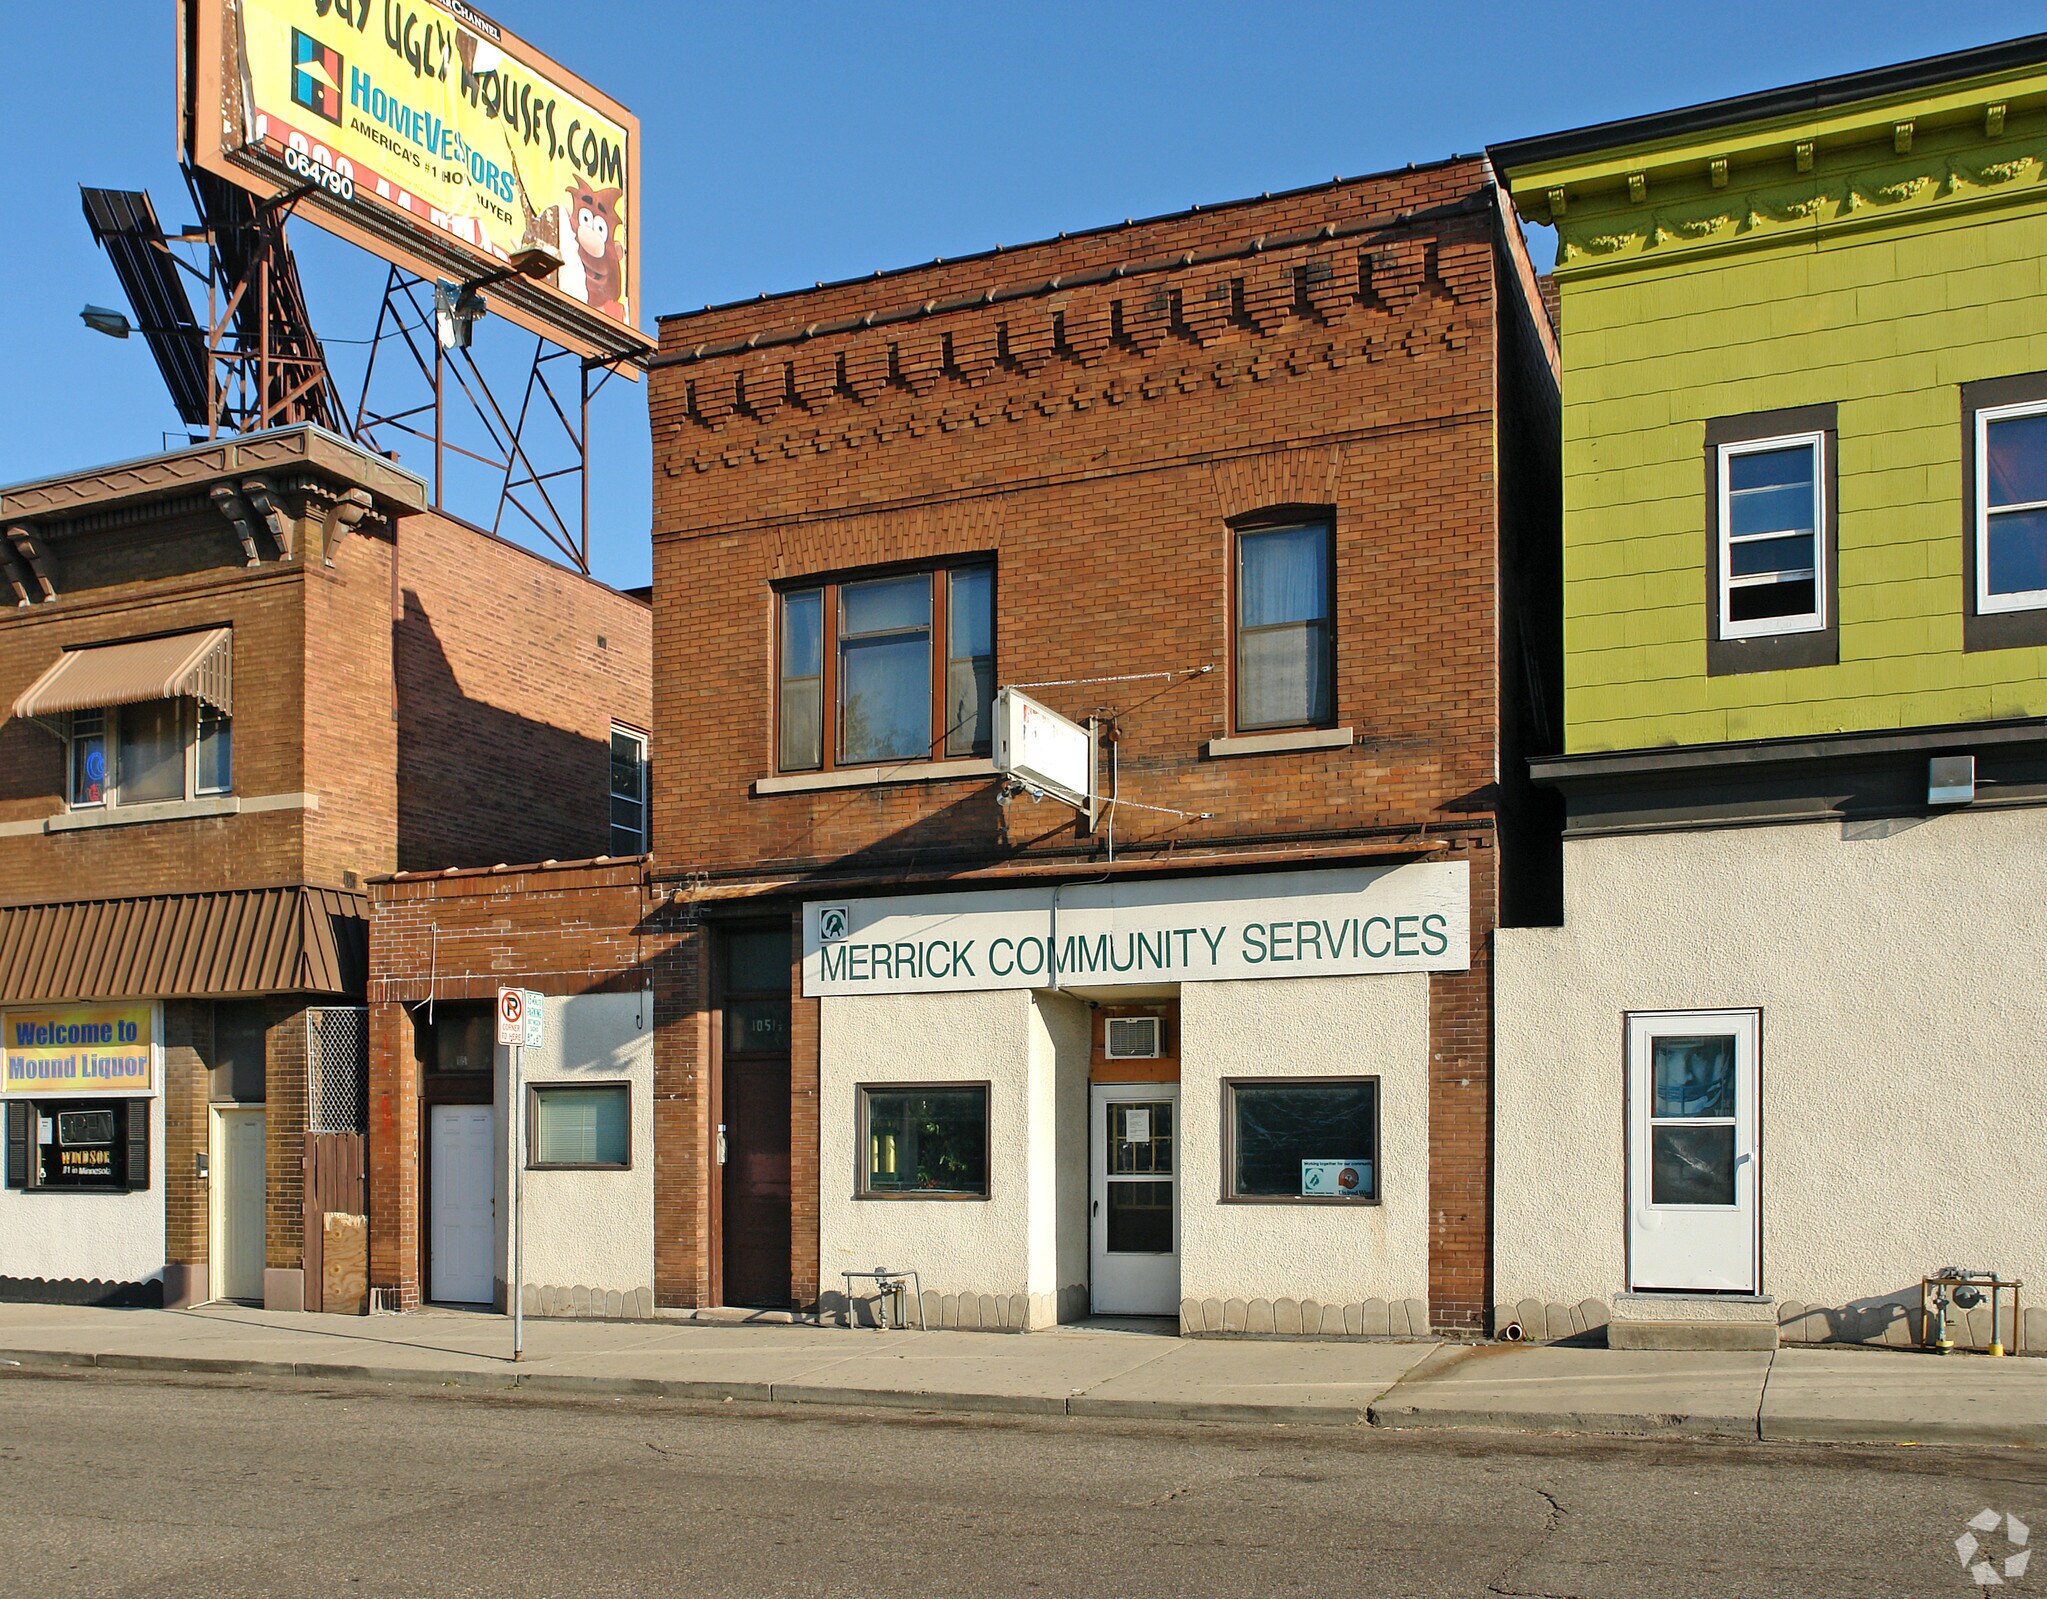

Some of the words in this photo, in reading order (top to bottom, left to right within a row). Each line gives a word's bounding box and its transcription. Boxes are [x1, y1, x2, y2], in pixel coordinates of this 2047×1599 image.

[385, 0, 452, 83] UGLY
[461, 64, 623, 190] HOUSES.COM
[284, 147, 354, 200] 064790
[350, 118, 421, 168] AMERICA'S
[424, 163, 437, 178] #1
[476, 192, 513, 225] UYER
[820, 939, 976, 982] MERRICK
[988, 926, 1227, 977] COMMUNITY
[1242, 913, 1448, 964] SERVICES
[16, 1020, 113, 1046] Welcome
[117, 1019, 138, 1042] to
[501, 1032, 507, 1040] TO
[508, 1033, 521, 1042] HERE
[502, 1023, 521, 1032] CORNER
[8, 1054, 76, 1080] Mound
[82, 1053, 147, 1080] Liquor
[71, 1165, 78, 1175] in
[78, 1166, 112, 1175] Minnesota
